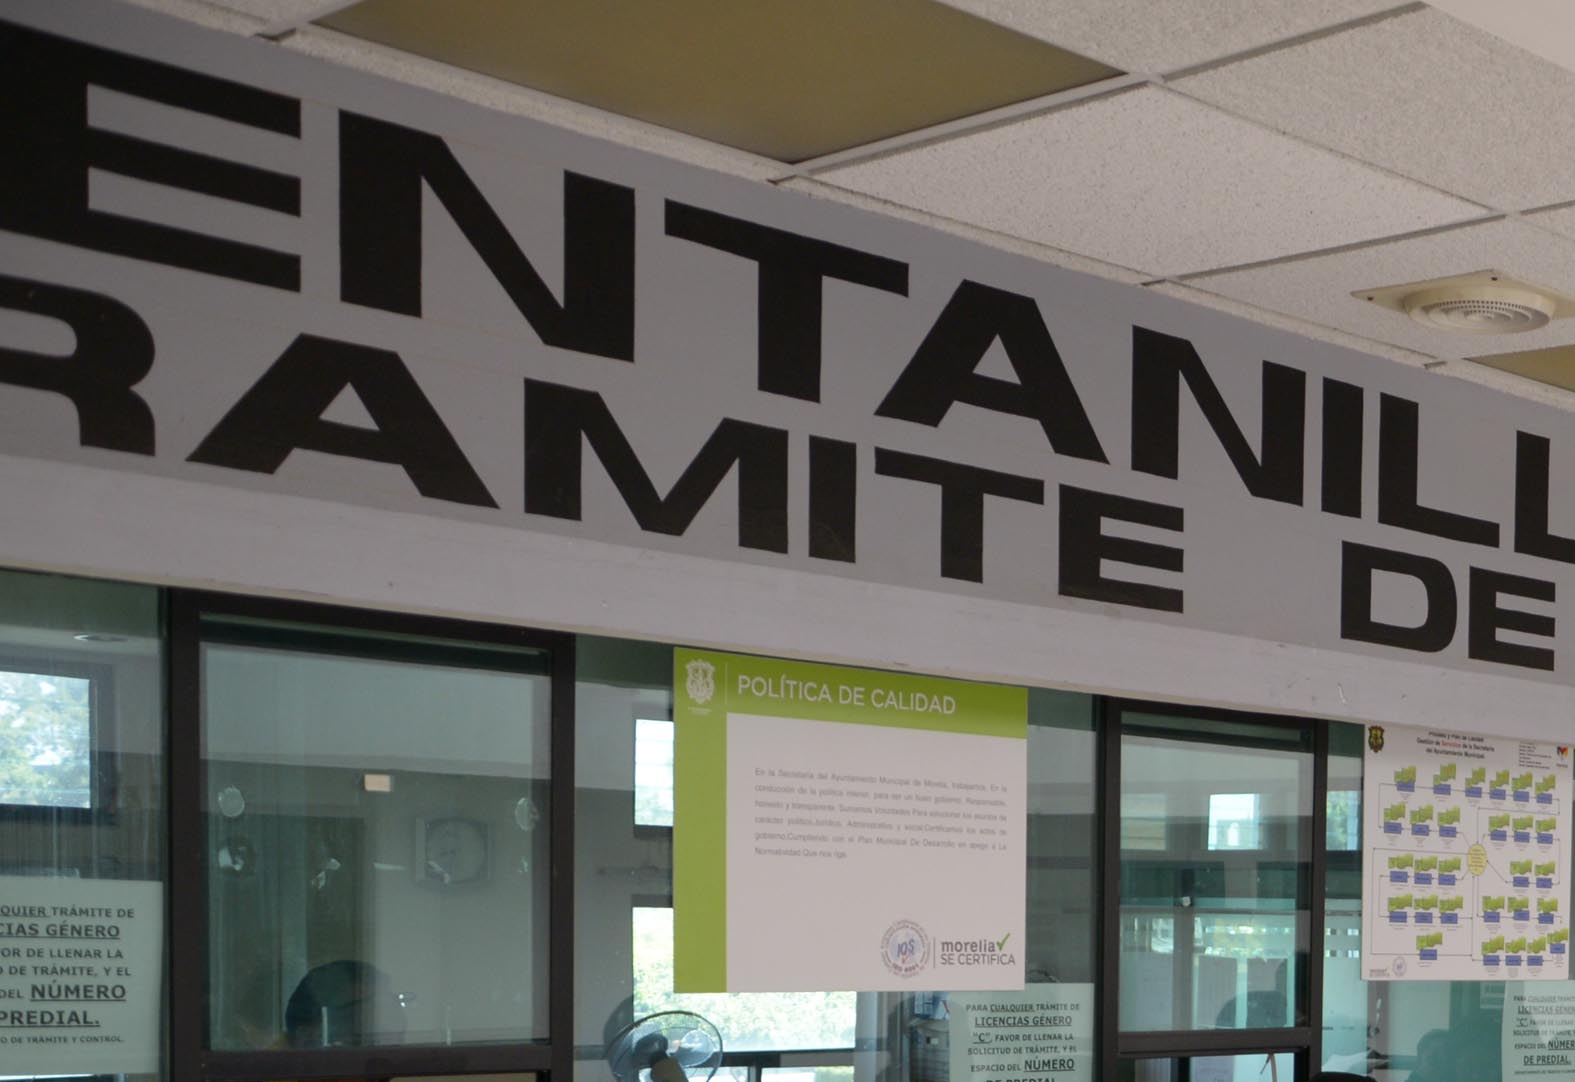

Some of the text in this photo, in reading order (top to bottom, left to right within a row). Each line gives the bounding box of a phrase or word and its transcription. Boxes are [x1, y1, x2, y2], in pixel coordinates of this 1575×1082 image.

[1340, 540, 1556, 672] DE
[737, 674, 956, 715] POLÍTICA DE CALIDAD
[52, 905, 112, 918] TRÁMITE
[117, 908, 135, 919] DE
[46, 921, 120, 938] GÉNERO
[941, 939, 996, 953] morelia
[26, 948, 44, 958] DE
[50, 948, 102, 959] LLENAR
[107, 950, 124, 960] LA
[940, 953, 1016, 966] SE CERTIFICA
[8, 965, 26, 976] DE
[104, 966, 111, 976] Y
[116, 966, 131, 977] EL
[30, 980, 126, 1000] NÚMERO
[975, 1012, 1072, 1027] LICENCIAS GÉNERO
[995, 1033, 1073, 1042] FAVOR DE LLENAR LA
[968, 1047, 1010, 1056] SOLICITUD
[971, 1056, 1075, 1072] ESPACIO DEL NÚMERO
[1524, 1055, 1534, 1066] DE
